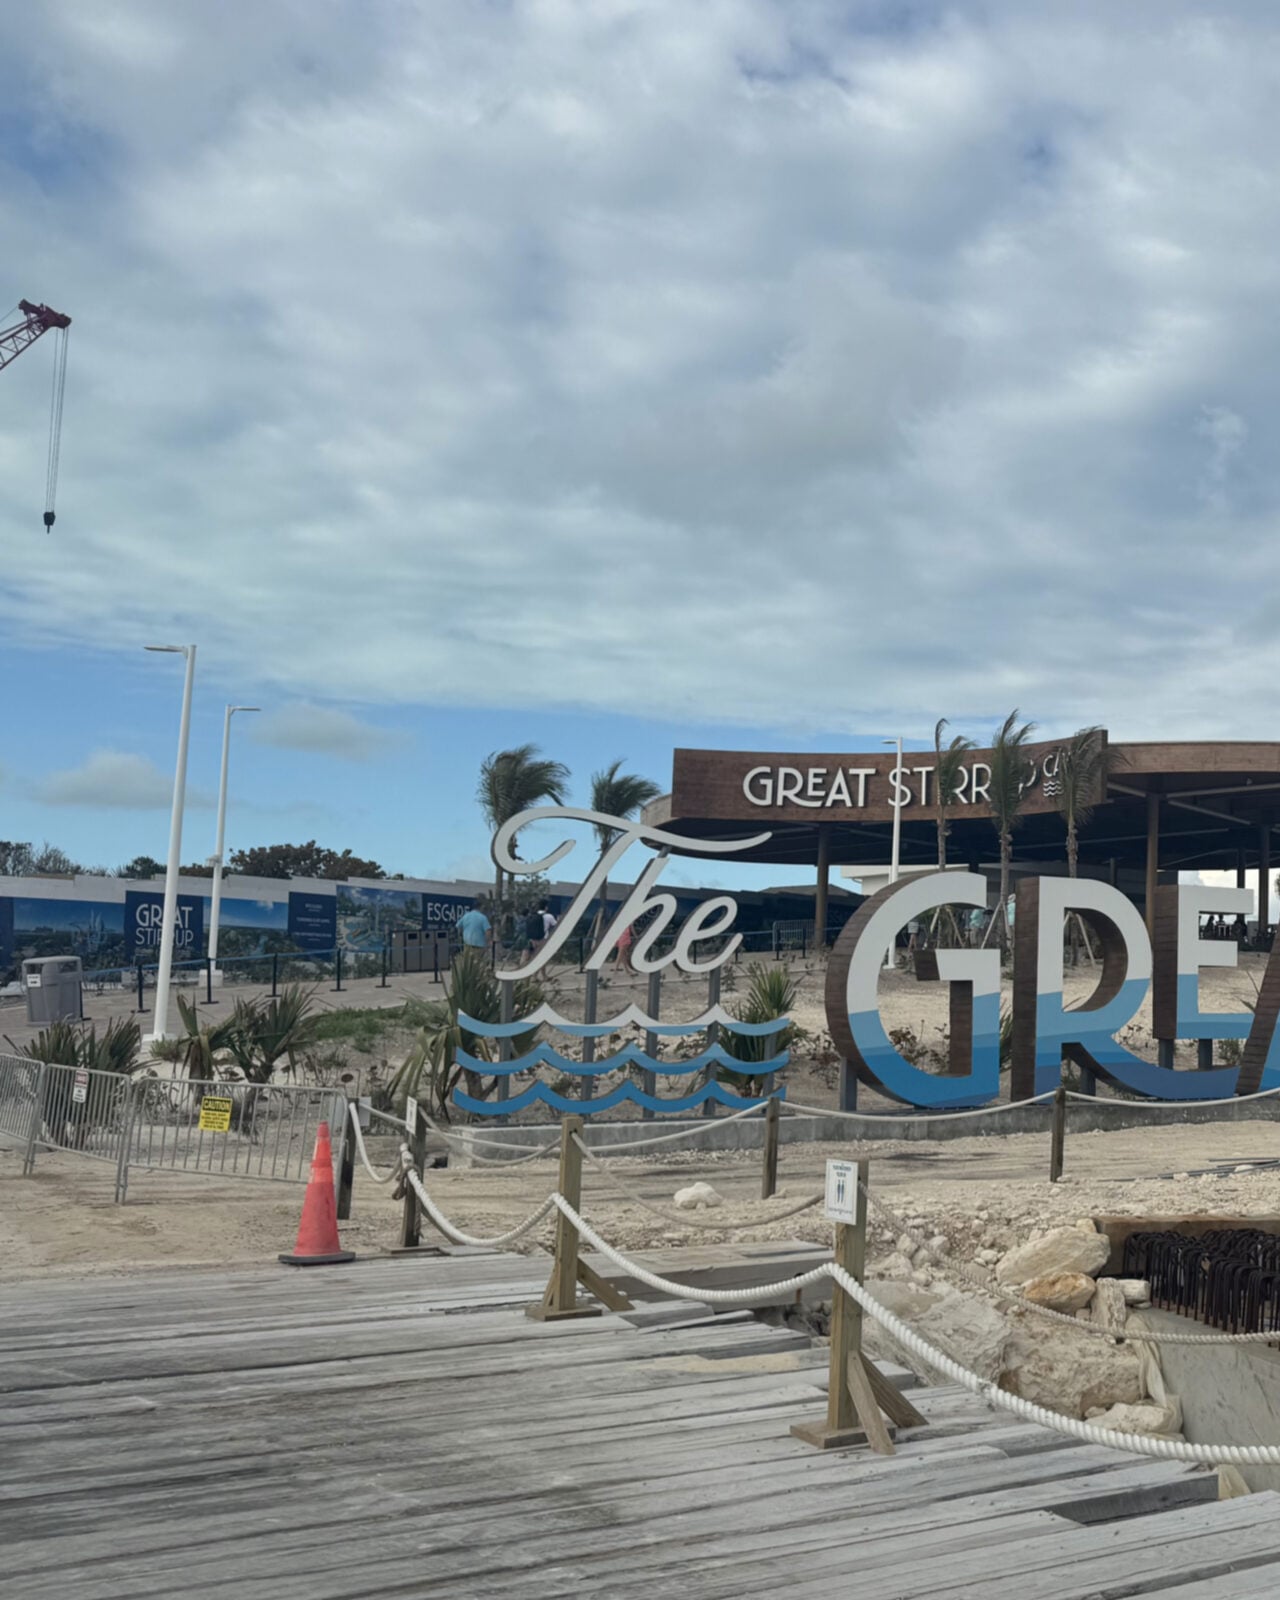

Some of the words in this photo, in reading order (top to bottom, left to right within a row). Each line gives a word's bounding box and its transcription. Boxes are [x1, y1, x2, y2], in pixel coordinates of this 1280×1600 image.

[742, 765, 877, 808] GREAT
[888, 757, 1038, 807] STRRP
[491, 805, 773, 981] The
[135, 903, 194, 929] GRAT
[135, 927, 194, 947] STIRUP
